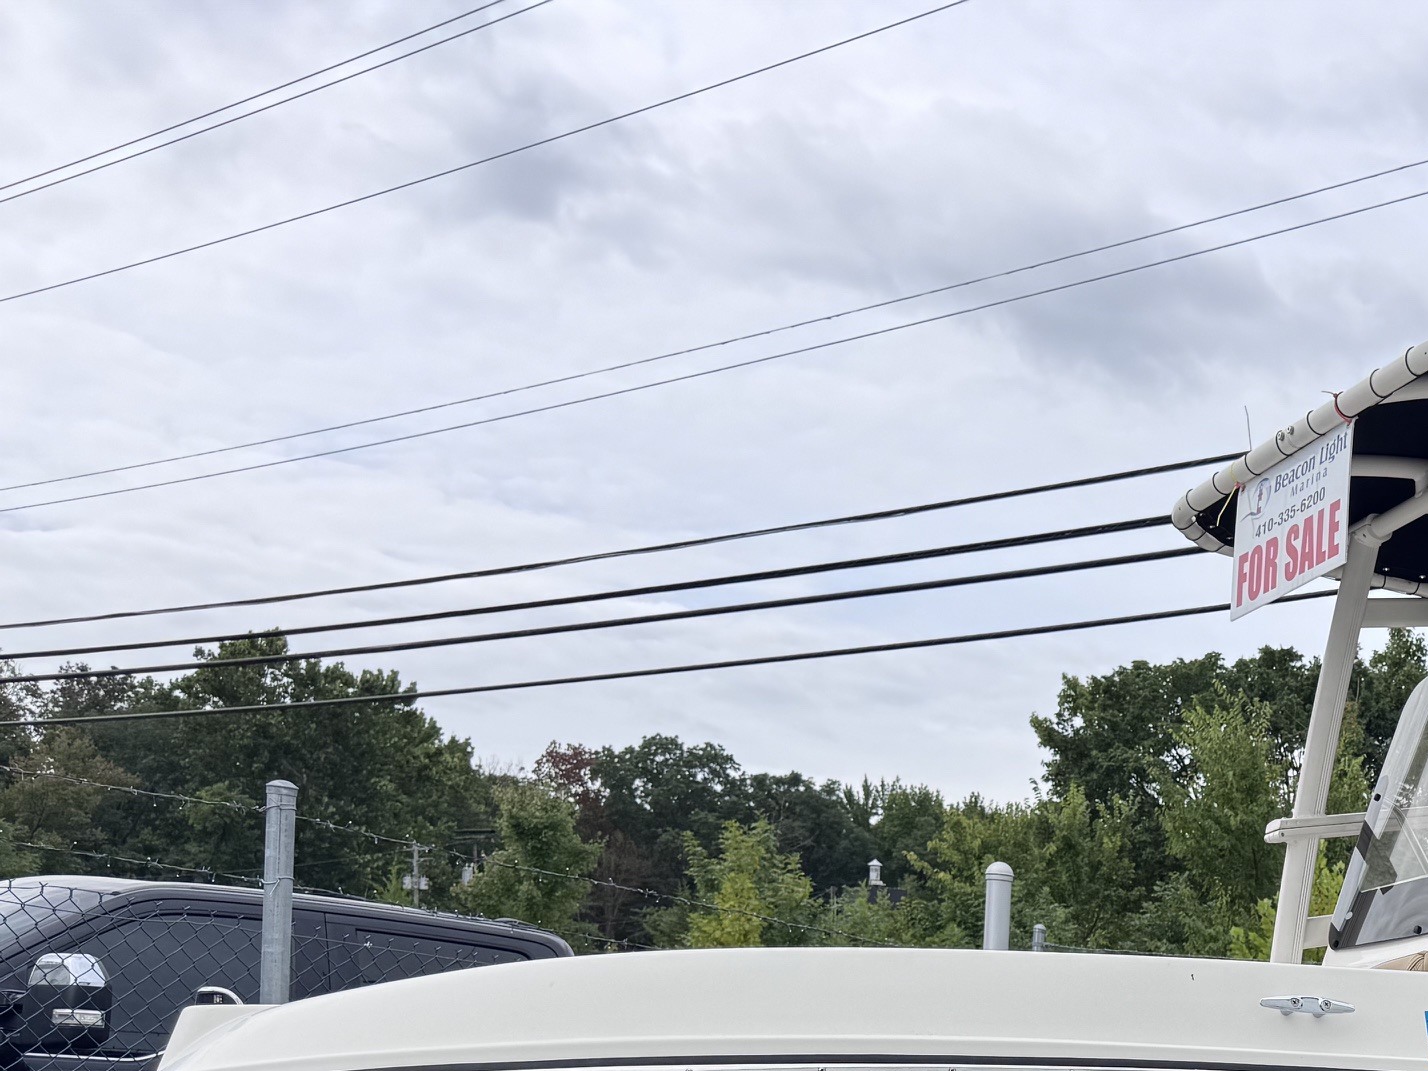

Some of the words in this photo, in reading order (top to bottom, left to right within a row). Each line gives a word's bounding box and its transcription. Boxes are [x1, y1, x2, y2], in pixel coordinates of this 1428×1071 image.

[1274, 456, 1316, 493] Beacon
[1319, 431, 1349, 465] Light
[1291, 467, 1328, 497] Marina
[1255, 486, 1326, 538] 410-335-6200
[1236, 536, 1279, 608] FOR
[1284, 499, 1341, 582] SALE
